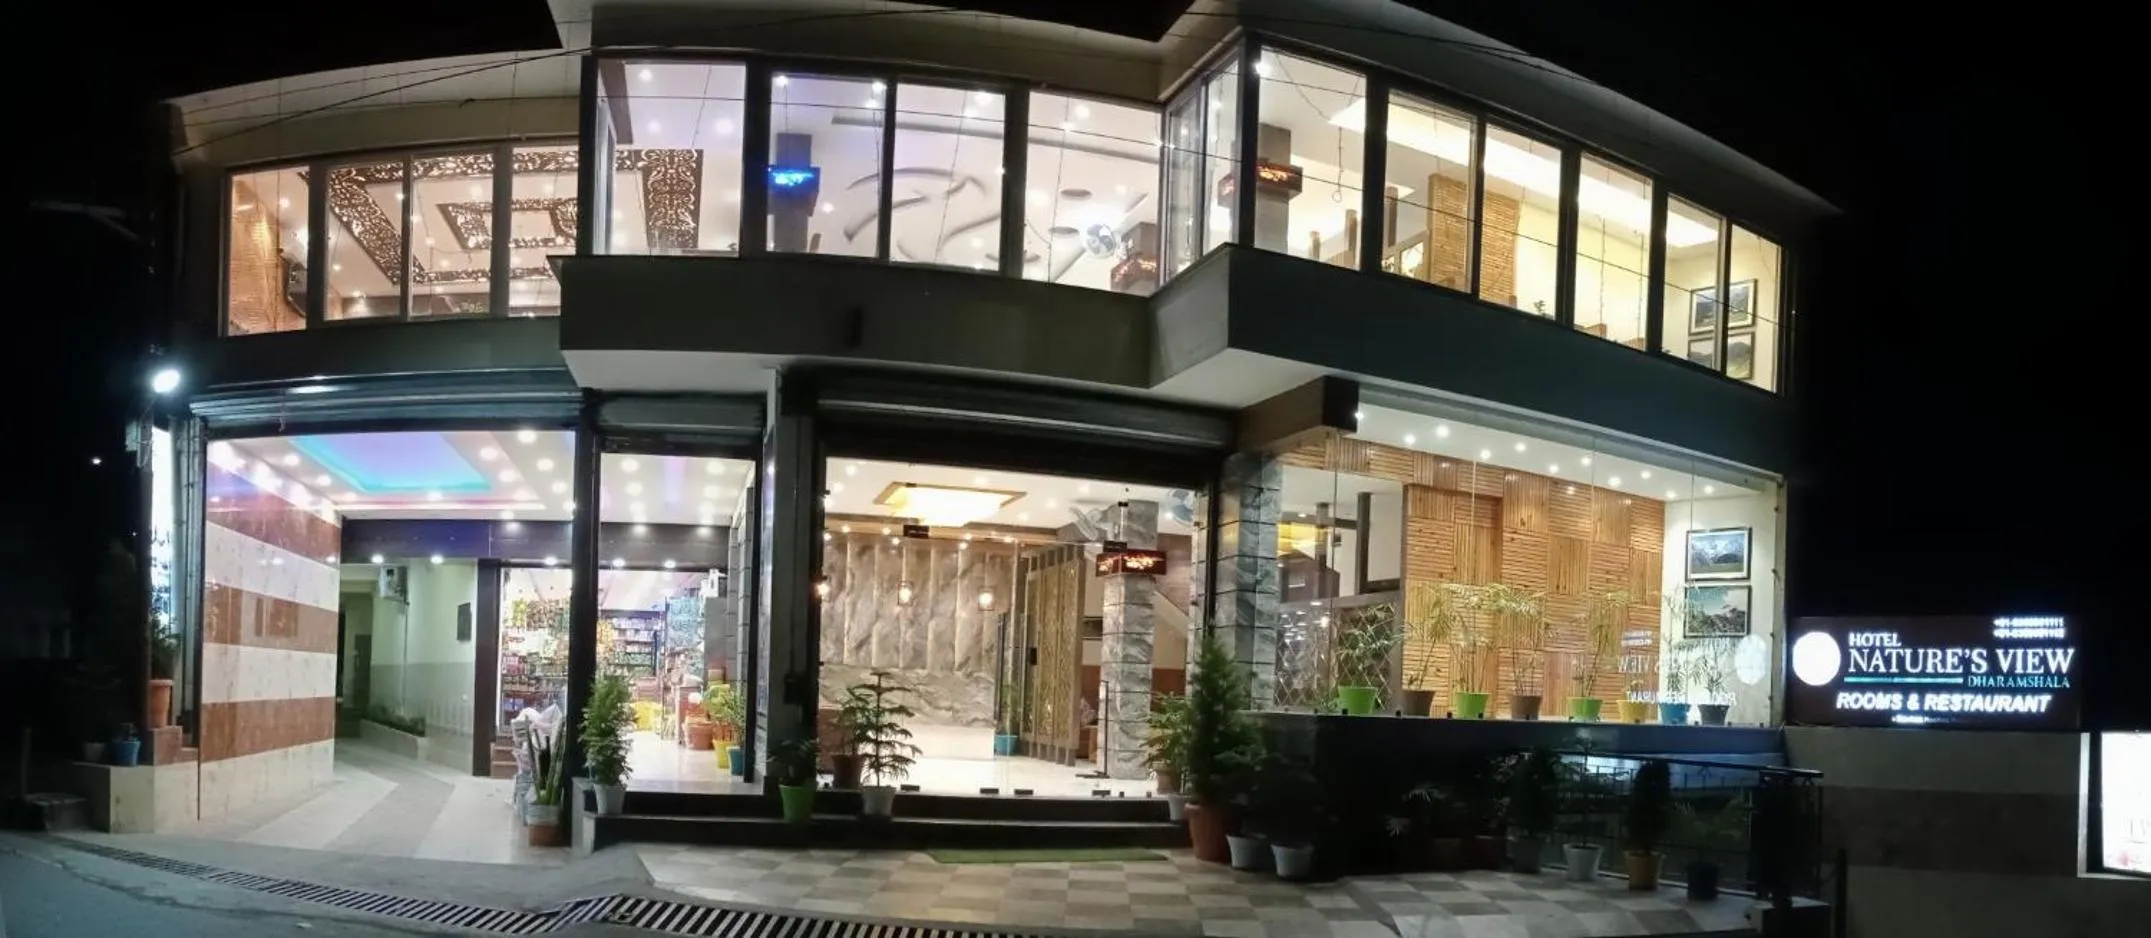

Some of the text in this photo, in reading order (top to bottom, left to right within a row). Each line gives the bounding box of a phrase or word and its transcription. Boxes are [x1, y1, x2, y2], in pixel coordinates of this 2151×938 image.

[1848, 632, 1901, 647] HOTEL
[1848, 648, 2074, 674] NATURE'S VIEW
[1967, 675, 2070, 689] DHARAMSHALA
[1836, 691, 2052, 713] ROOMS & RESTAURANT
